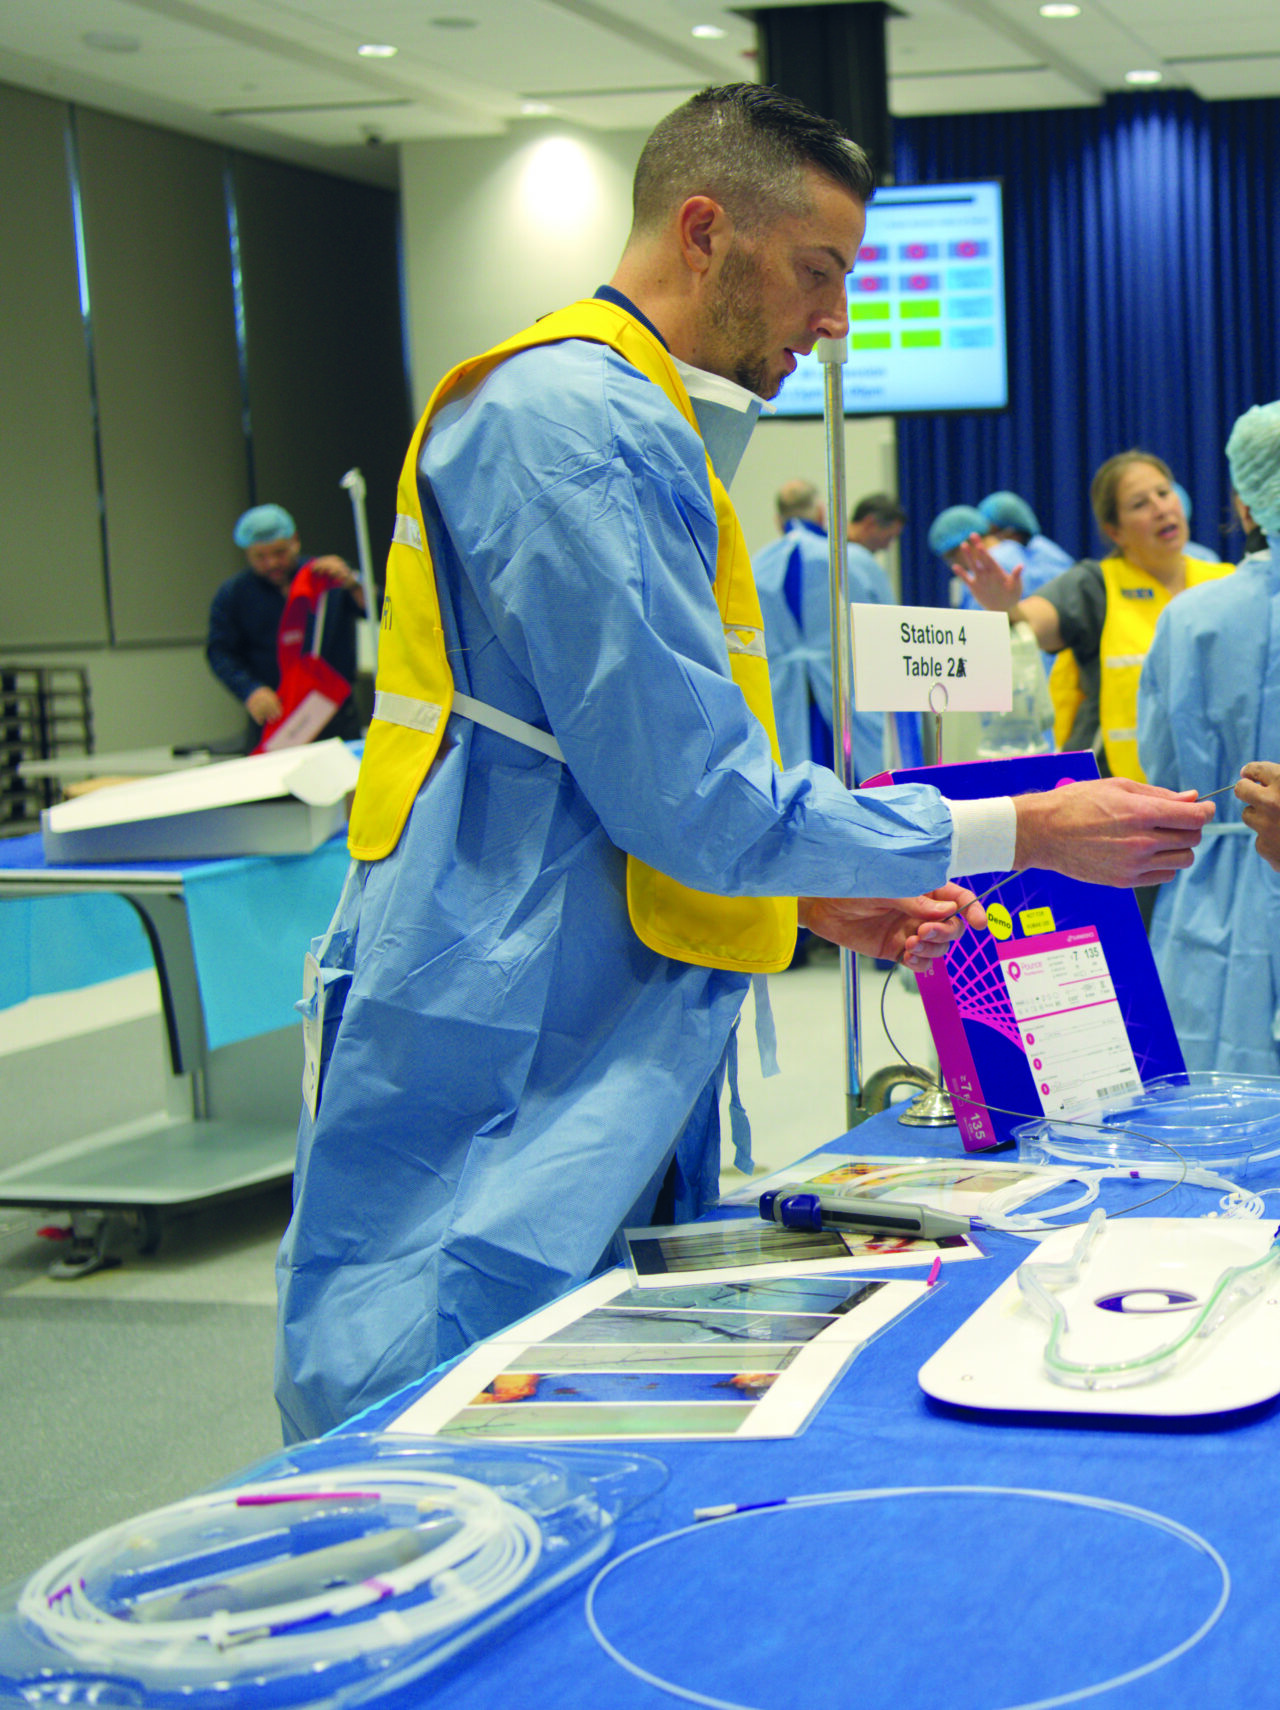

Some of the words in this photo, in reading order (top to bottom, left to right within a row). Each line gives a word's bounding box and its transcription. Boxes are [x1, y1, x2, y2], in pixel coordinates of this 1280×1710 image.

[900, 622, 954, 645] Station
[958, 626, 967, 645] 4
[903, 655, 942, 677] Table
[988, 913, 1011, 929] Demo
[1084, 946, 1099, 959] 135
[960, 1081, 973, 1091] 7
[970, 1112, 986, 1140] 135
